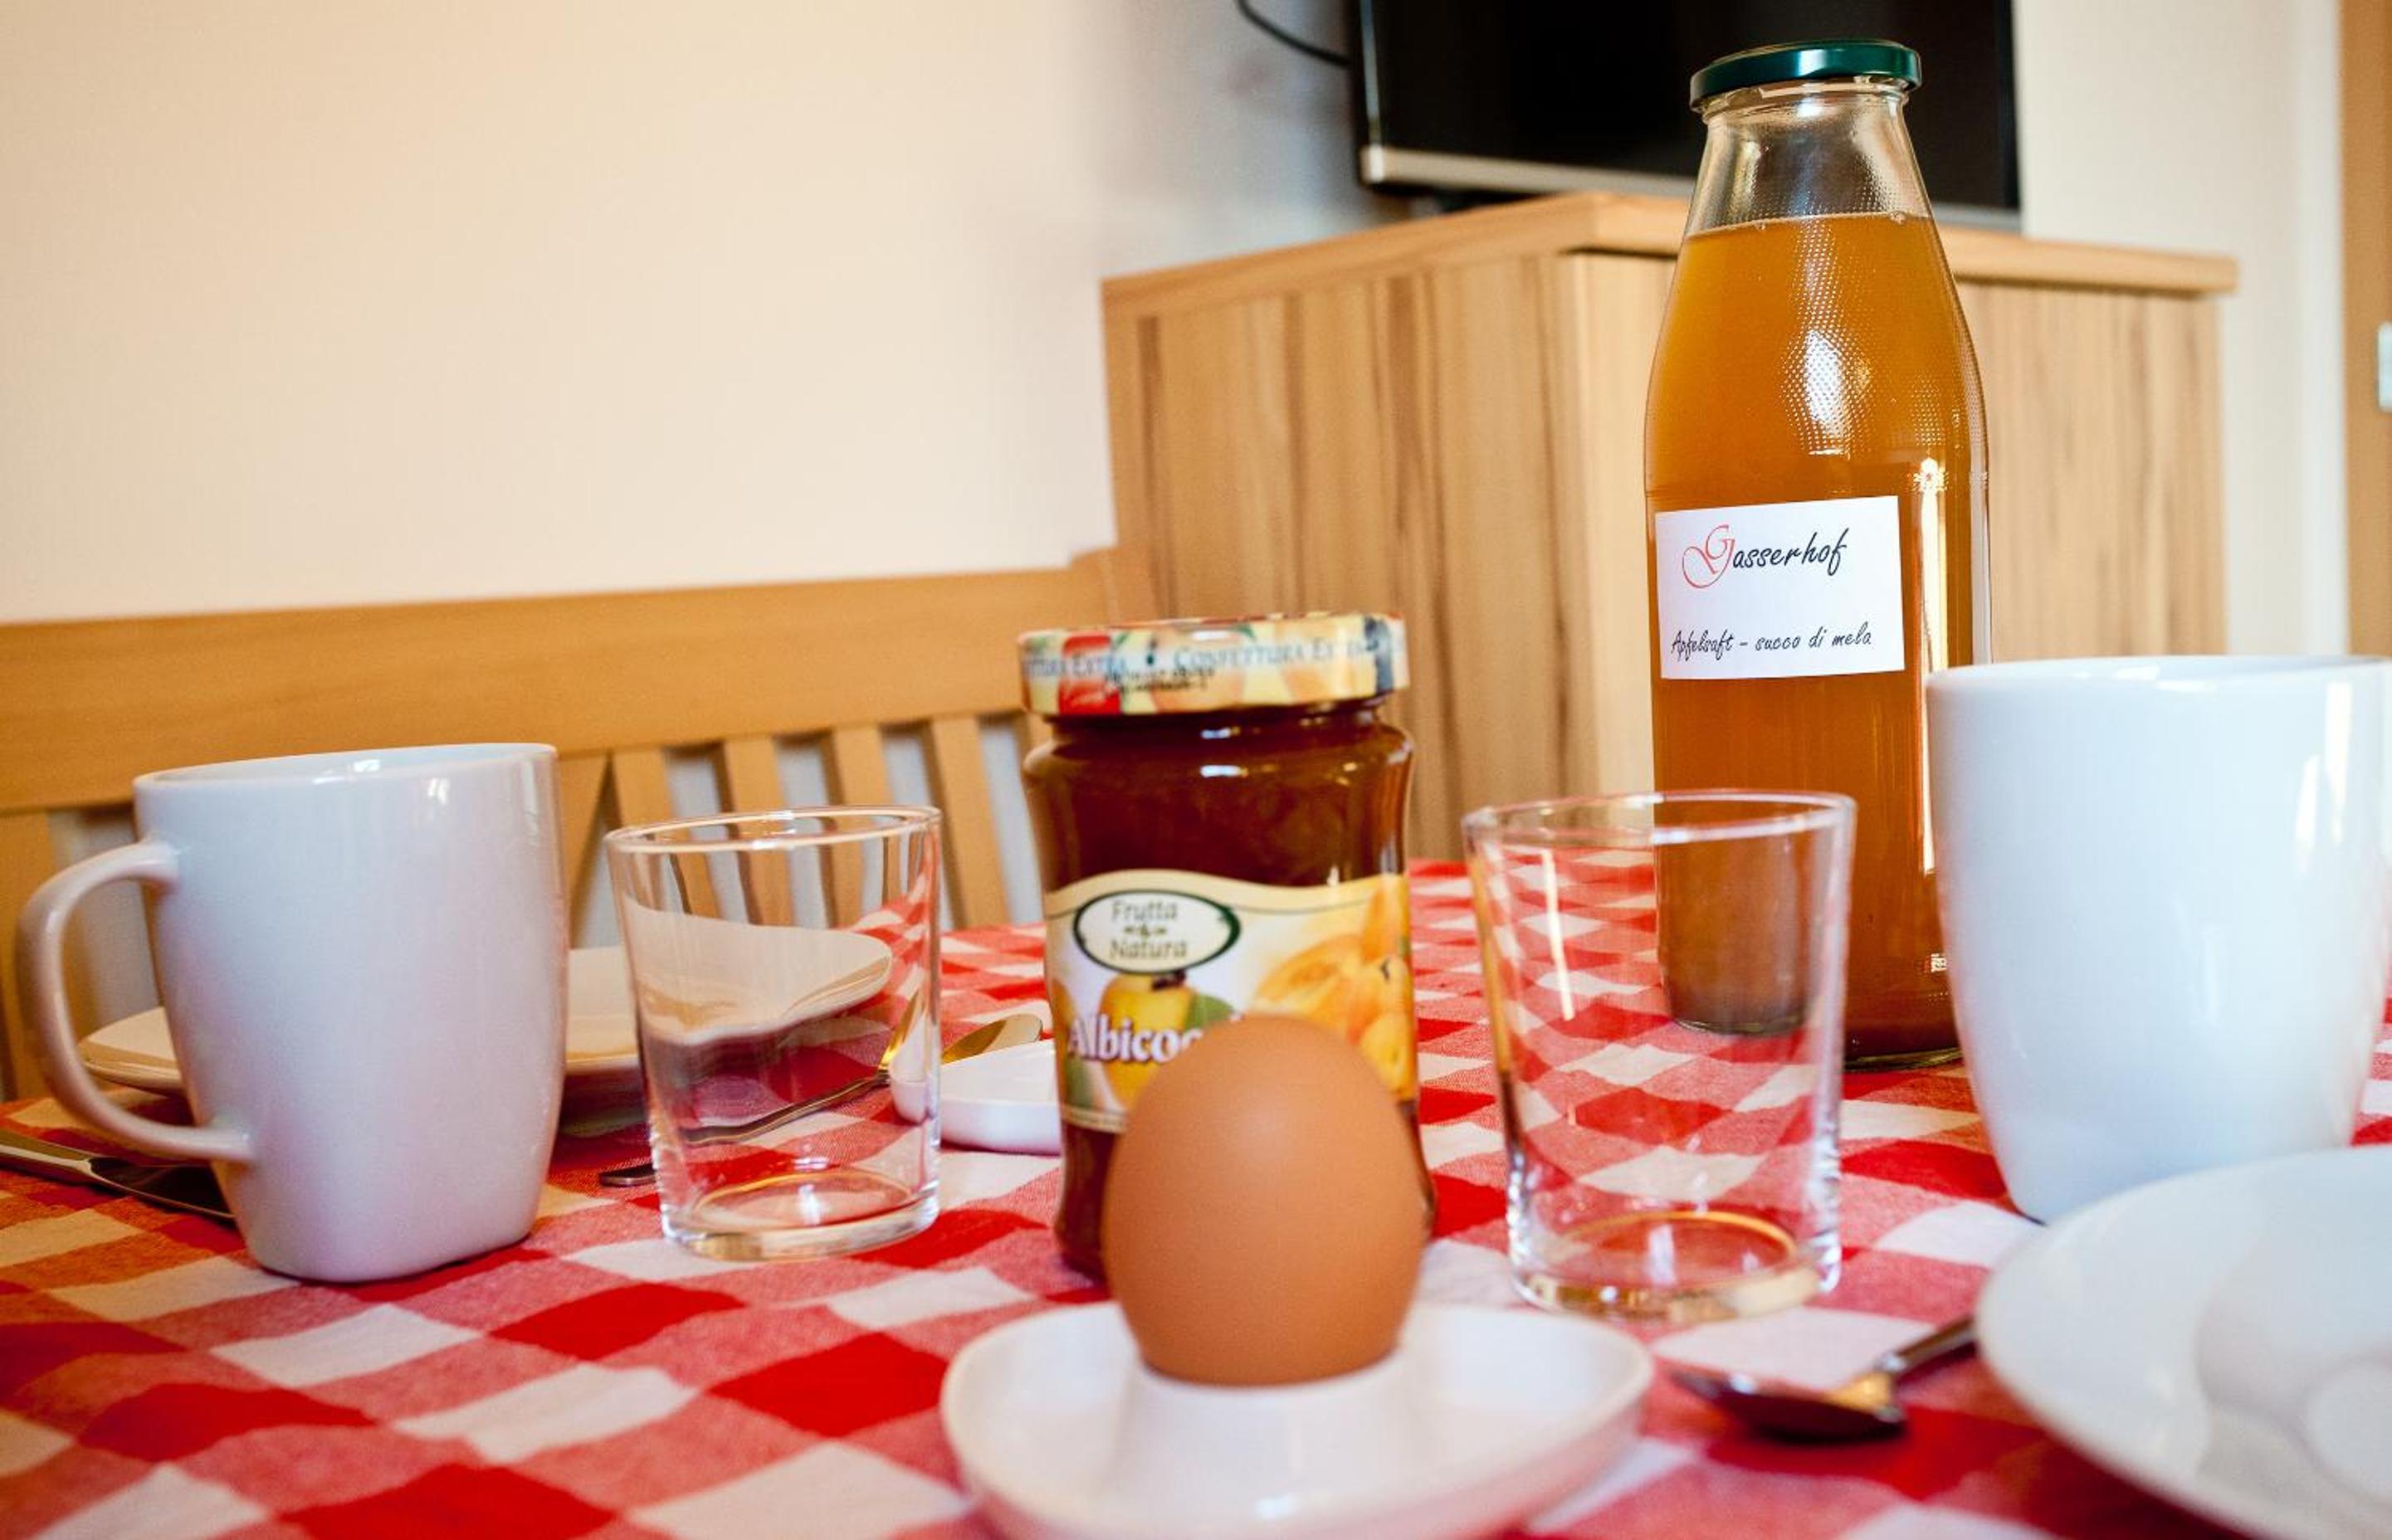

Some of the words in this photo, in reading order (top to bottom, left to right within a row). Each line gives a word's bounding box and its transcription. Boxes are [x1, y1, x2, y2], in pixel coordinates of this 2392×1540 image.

[1682, 524, 1849, 588] Gasserhof
[1671, 628, 1734, 662] Apfelsaft
[1755, 636, 1799, 651] succo
[1809, 626, 1828, 648] di
[1832, 621, 1872, 646] mela
[1111, 899, 1179, 922] Frutta
[1110, 939, 1188, 960] Natura
